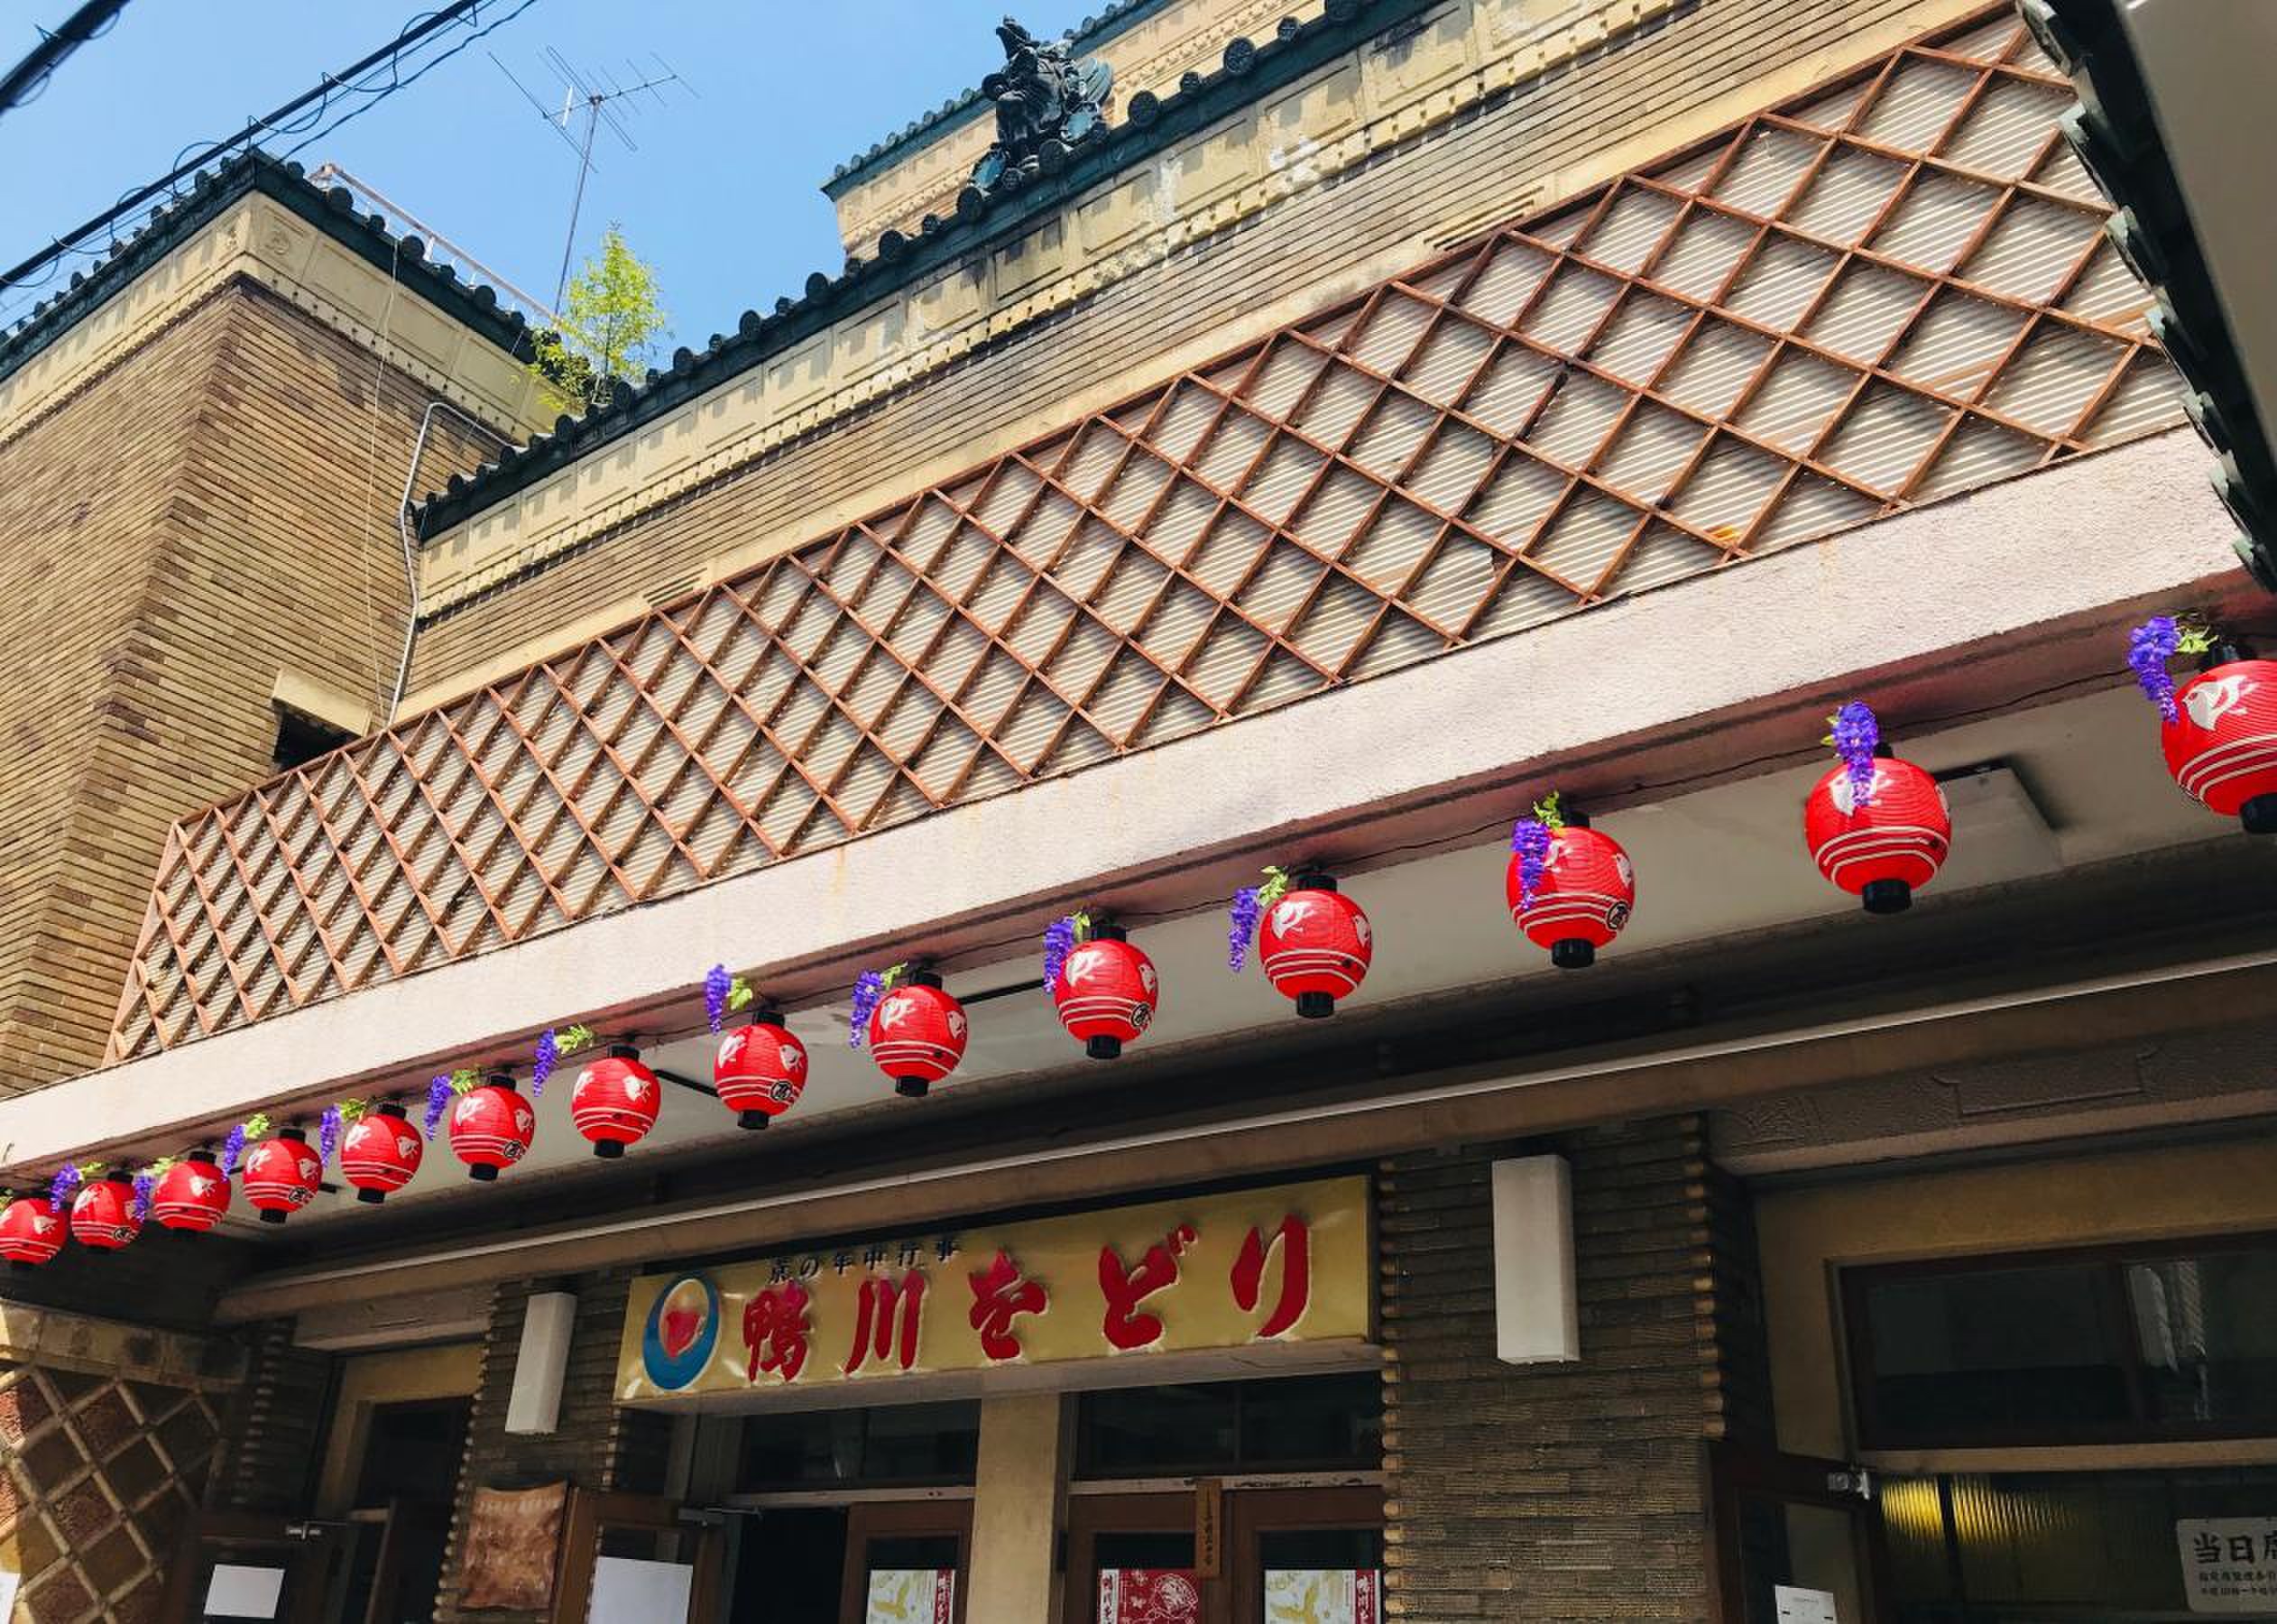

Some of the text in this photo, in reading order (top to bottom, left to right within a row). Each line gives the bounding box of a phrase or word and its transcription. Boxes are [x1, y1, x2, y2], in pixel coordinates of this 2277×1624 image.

[742, 1213, 1311, 1384] 鴨川をどり
